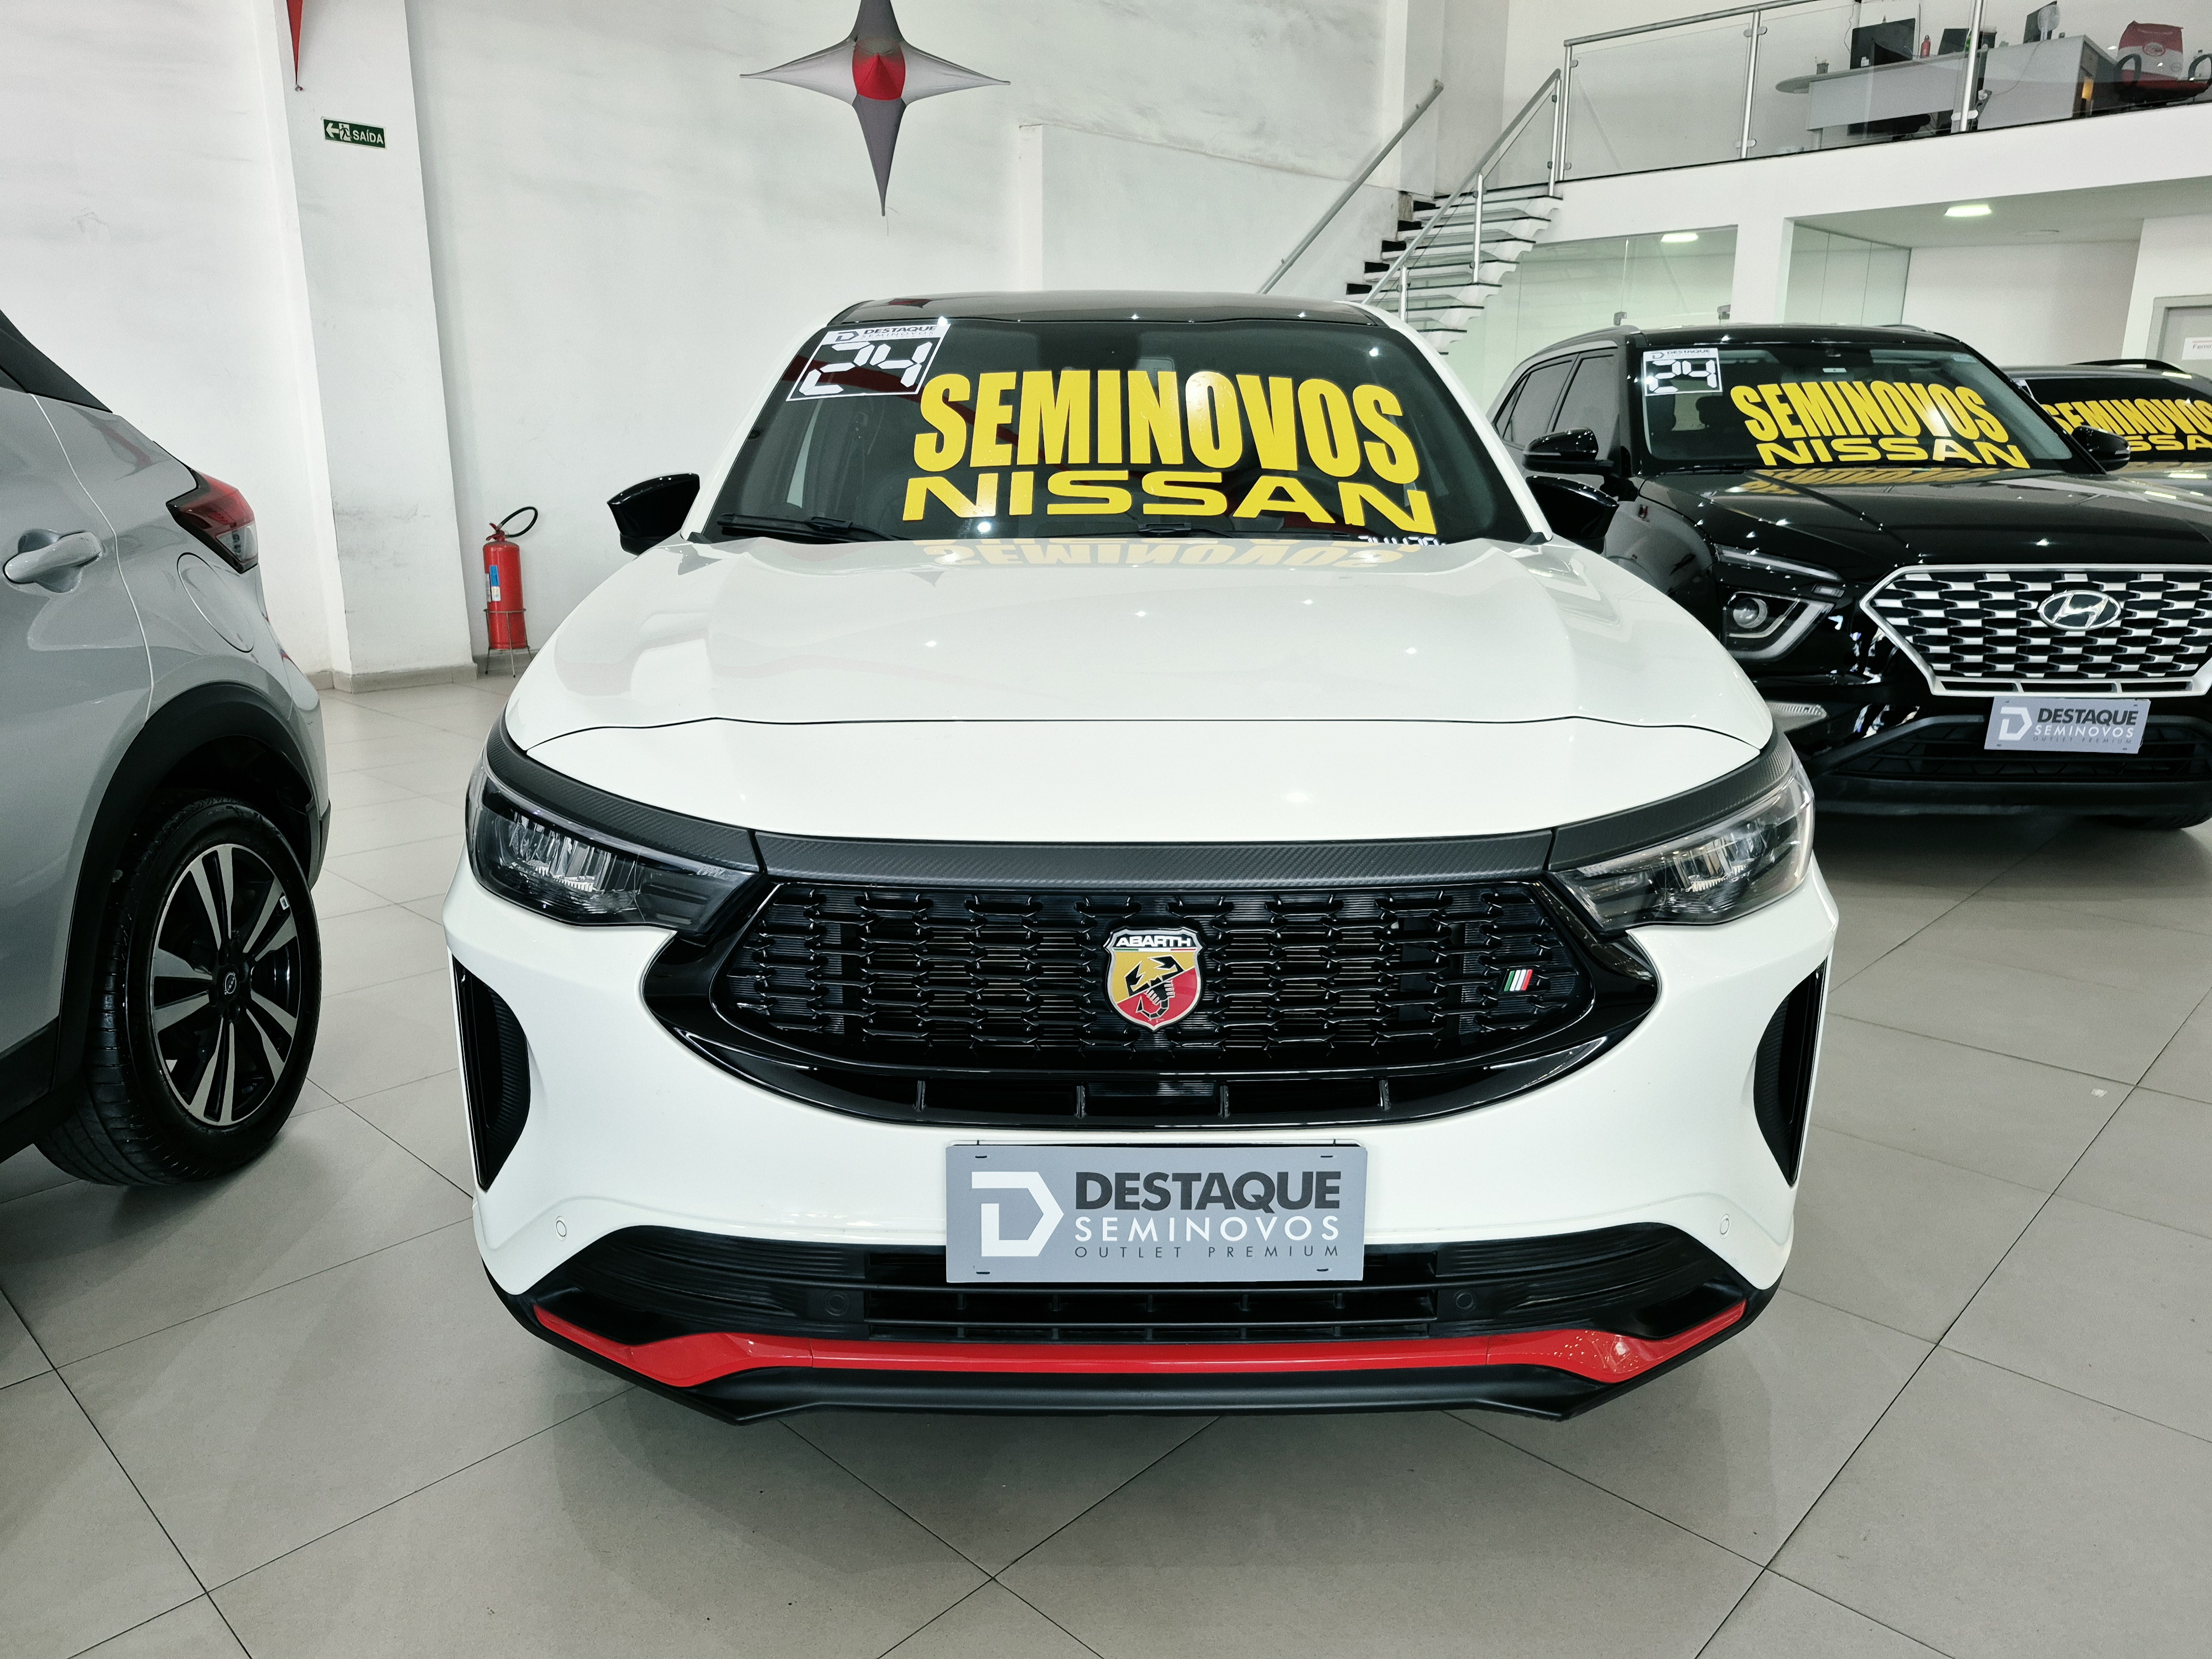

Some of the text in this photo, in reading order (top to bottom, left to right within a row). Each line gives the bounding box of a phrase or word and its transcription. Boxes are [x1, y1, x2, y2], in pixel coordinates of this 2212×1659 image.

[352, 129, 384, 144] SAÍDA
[864, 326, 937, 334] DESTAQUE
[799, 341, 932, 397] 24
[1648, 359, 1718, 394] 24
[1730, 380, 2009, 443] SEMINOVOS
[913, 369, 1420, 484] SEMINOVOS
[1756, 437, 2031, 469] NISSAN
[902, 470, 1437, 535] NISSAN
[2034, 724, 2134, 738] SEMINOVOS
[2037, 708, 2138, 726] DESTAQUE
[1116, 935, 1191, 947] ABARTH
[1075, 1171, 1342, 1214] DESTAQUE
[1075, 1215, 1339, 1242] SEMINOVOS
[1075, 1245, 1338, 1259] OUTLET PREMIUM
